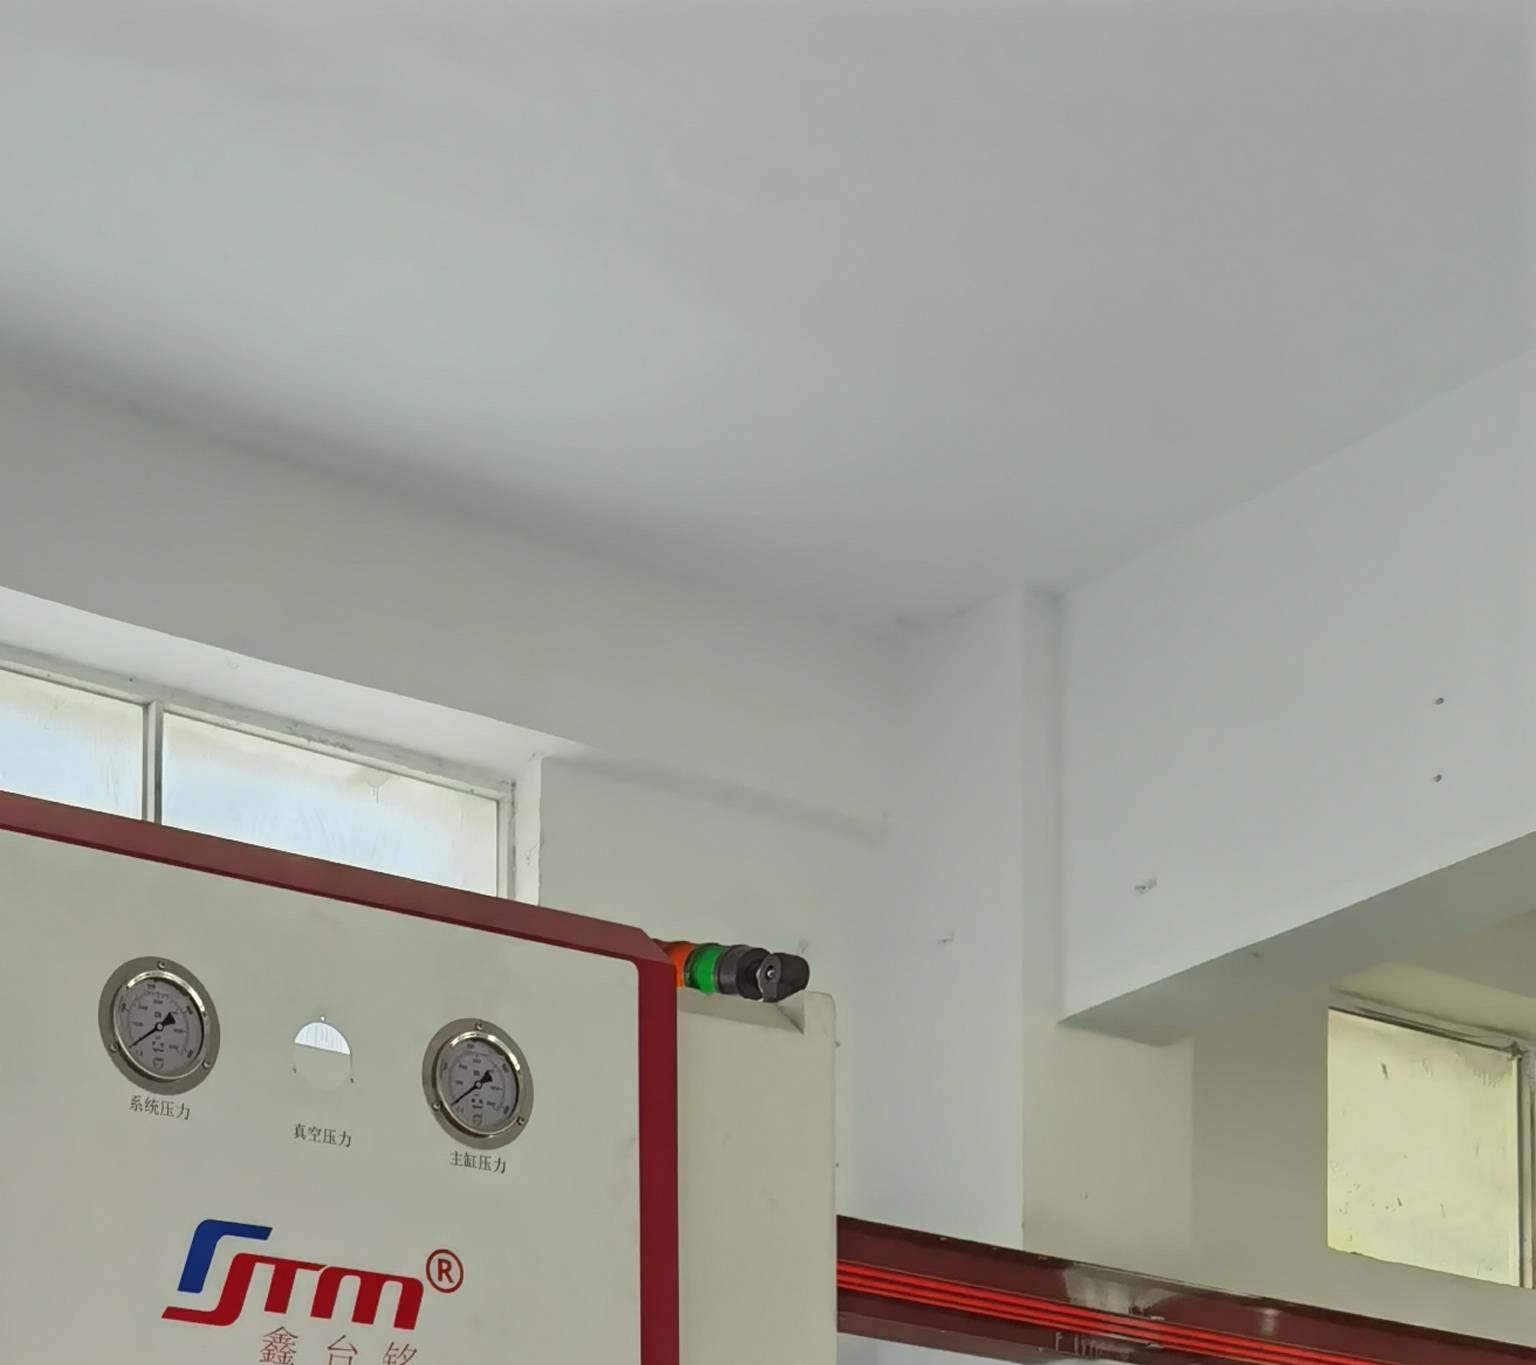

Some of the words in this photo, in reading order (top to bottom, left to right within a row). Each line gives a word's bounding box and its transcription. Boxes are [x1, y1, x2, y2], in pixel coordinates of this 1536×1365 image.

[128, 1095, 191, 1121] 系统压力
[448, 1150, 506, 1174] 主缸压力
